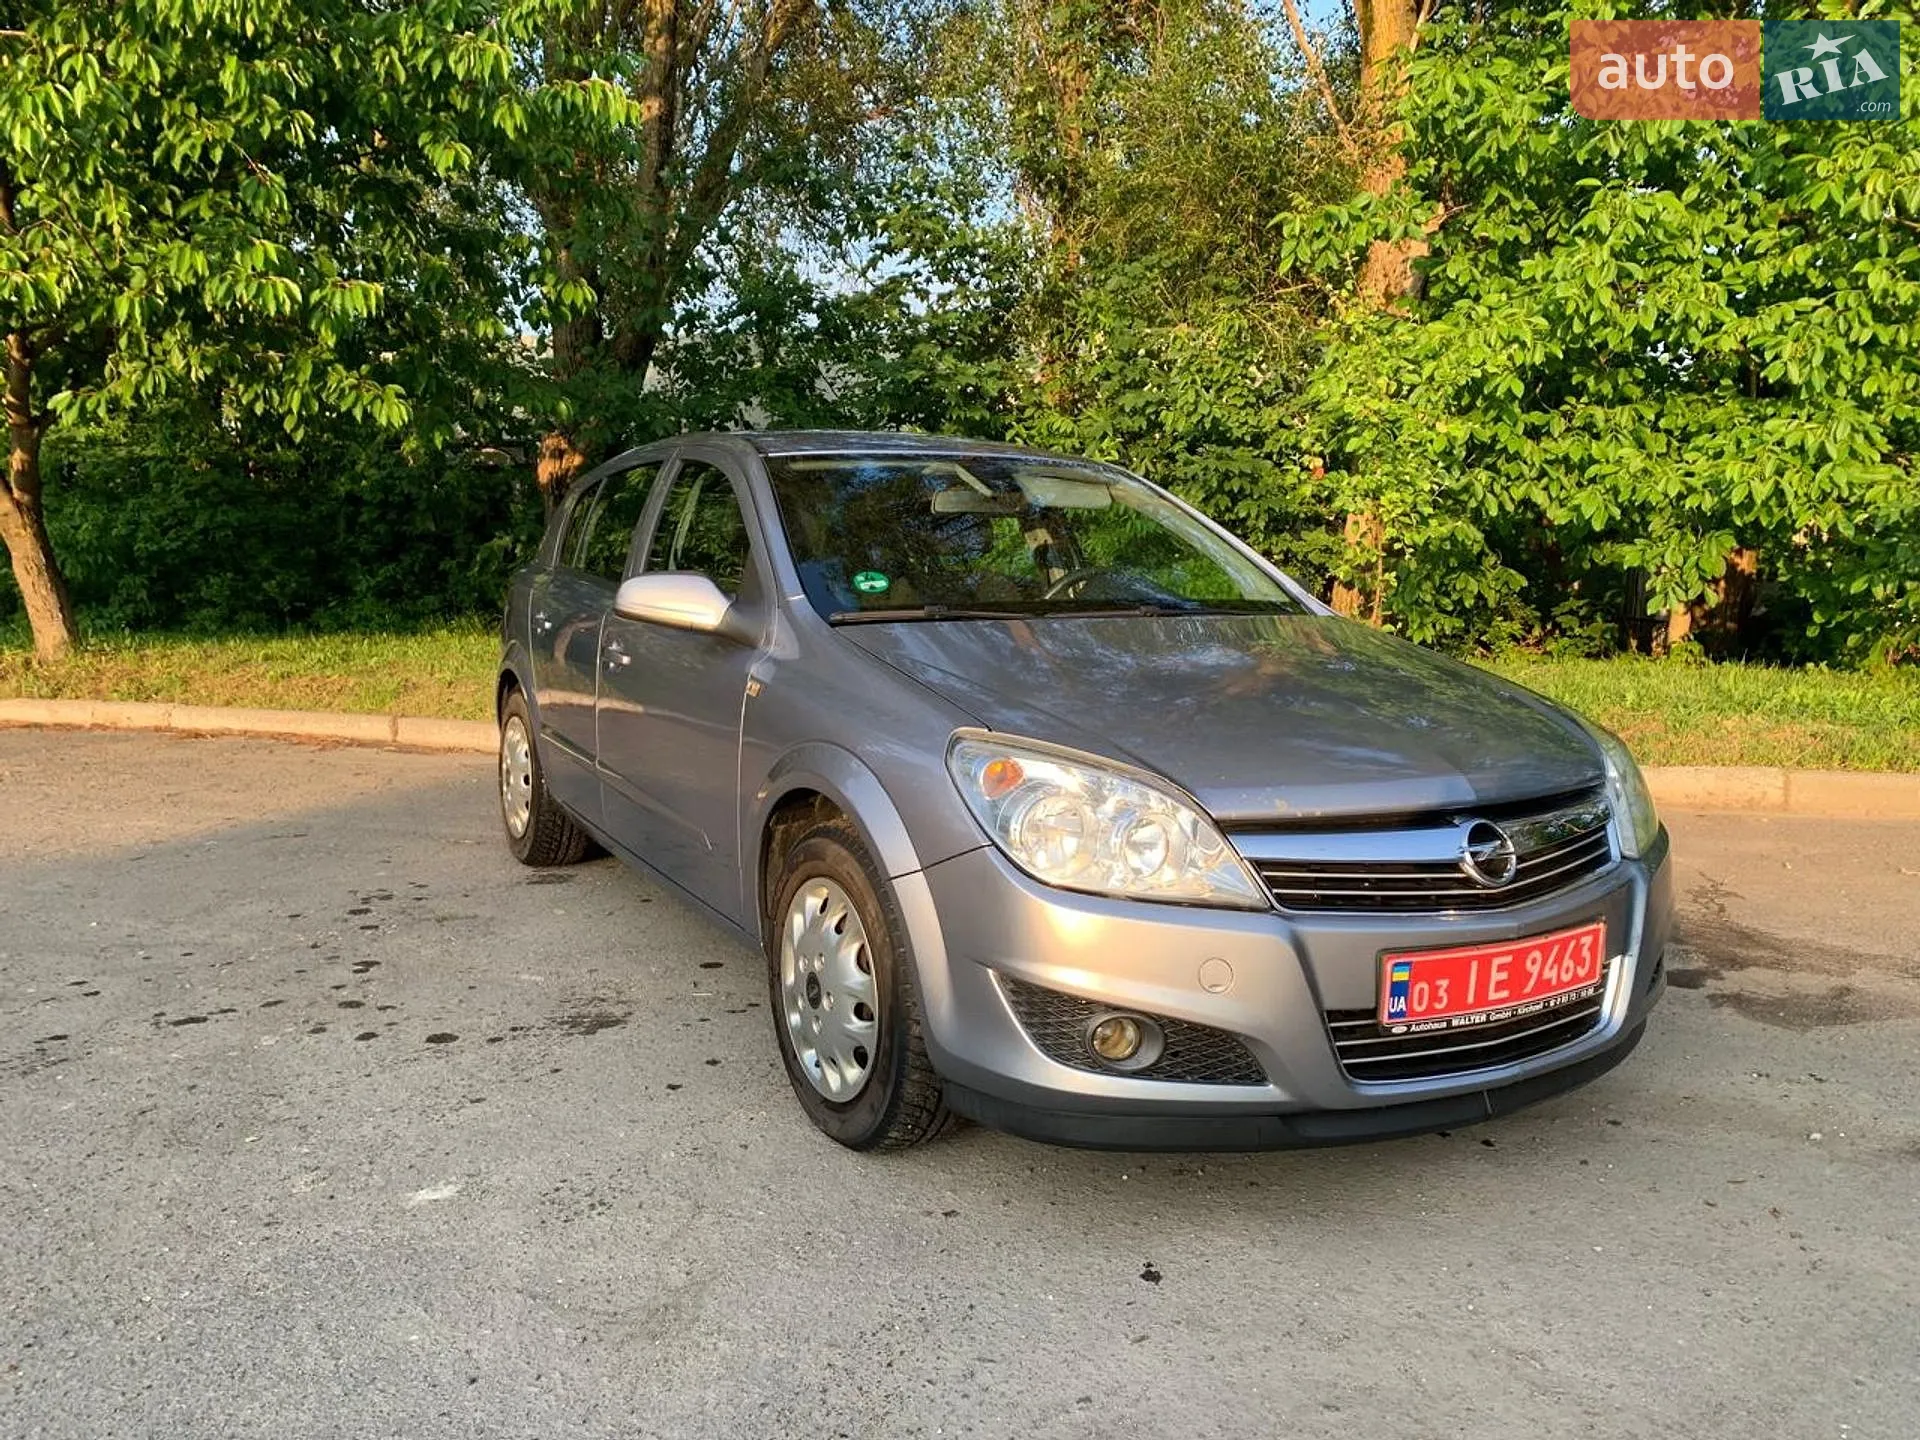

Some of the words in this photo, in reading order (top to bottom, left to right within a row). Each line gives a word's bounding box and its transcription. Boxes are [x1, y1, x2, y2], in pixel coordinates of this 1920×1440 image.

[1413, 978, 1450, 1013] 03
[1466, 954, 1514, 1005] IE
[1522, 935, 1594, 995] 9463
[1388, 995, 1407, 1013] UA
